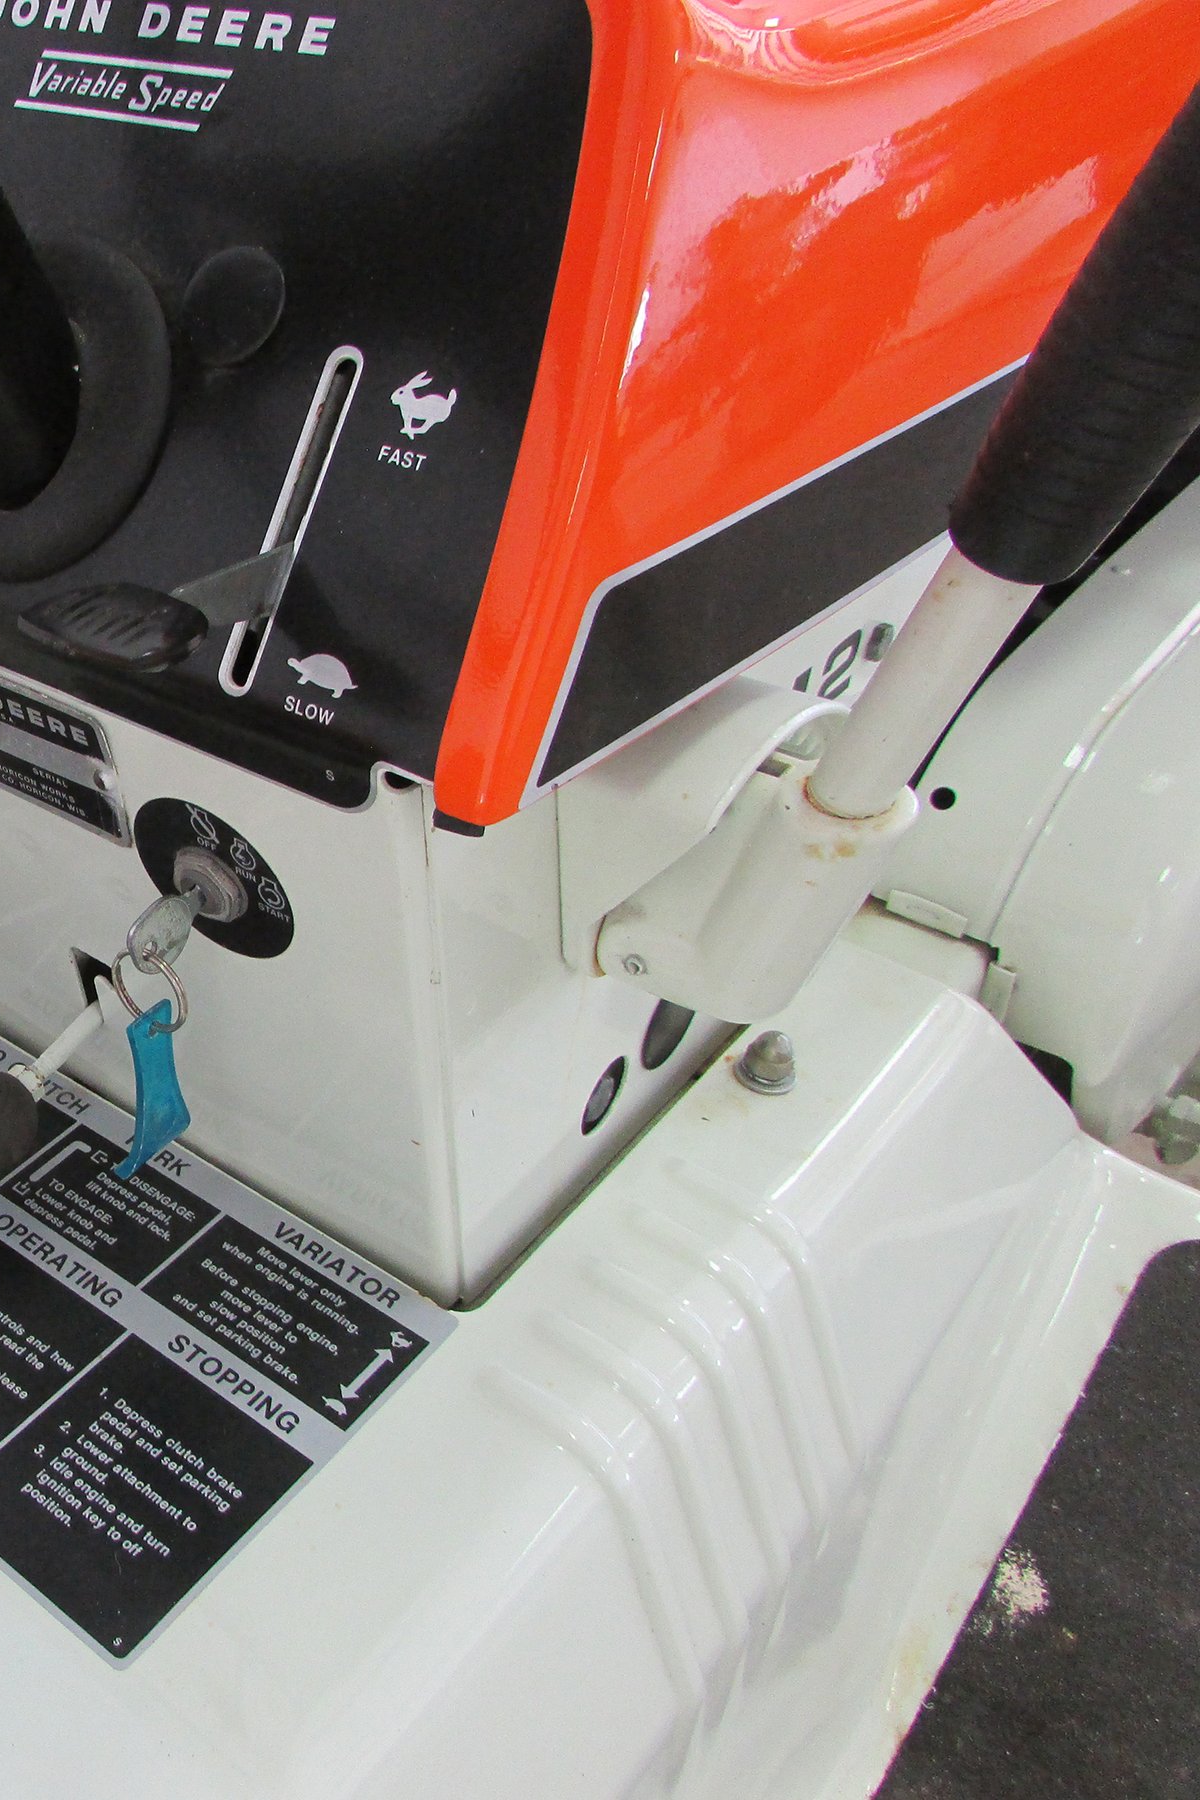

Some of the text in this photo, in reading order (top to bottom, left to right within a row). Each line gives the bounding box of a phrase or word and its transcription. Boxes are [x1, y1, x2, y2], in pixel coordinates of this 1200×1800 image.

[138, 3, 336, 55] DEERE
[28, 61, 225, 113] Variable Speed
[378, 445, 427, 471] FAST
[283, 695, 335, 727] SLOW
[196, 836, 217, 851] OFF
[235, 866, 257, 882] RUN
[258, 902, 291, 922] START
[48, 1177, 64, 1191] TO
[96, 1171, 138, 1202] Depress
[99, 1190, 126, 1211] knob
[125, 1209, 149, 1224] and
[146, 1220, 170, 1241] lock.
[222, 1241, 358, 1335] when engine is running.
[256, 1246, 346, 1307] Move lever only
[274, 1221, 400, 1309] VARIATOR
[200, 1258, 338, 1356] Before stopping engine,
[209, 1300, 285, 1354] slow position
[220, 1289, 297, 1343] move lever to
[25, 1335, 50, 1353] and
[49, 1350, 74, 1372] how
[172, 1293, 298, 1384] and set parking brake.
[167, 1334, 301, 1434] STOPPING
[88, 1420, 123, 1454] brake.
[99, 1411, 230, 1512] pedal and set parking
[113, 1398, 162, 1438] Depress
[165, 1438, 204, 1470] clutch
[206, 1467, 242, 1498] brake
[61, 1446, 108, 1485] ground.
[76, 1434, 113, 1464] Lower
[112, 1464, 182, 1519] attachment
[182, 1516, 196, 1531] to
[20, 1482, 70, 1527] position.
[36, 1468, 143, 1556] ignition key to off
[49, 1456, 73, 1479] Idle
[74, 1478, 115, 1513] engine
[116, 1512, 144, 1534] and
[142, 1530, 170, 1556] turn
